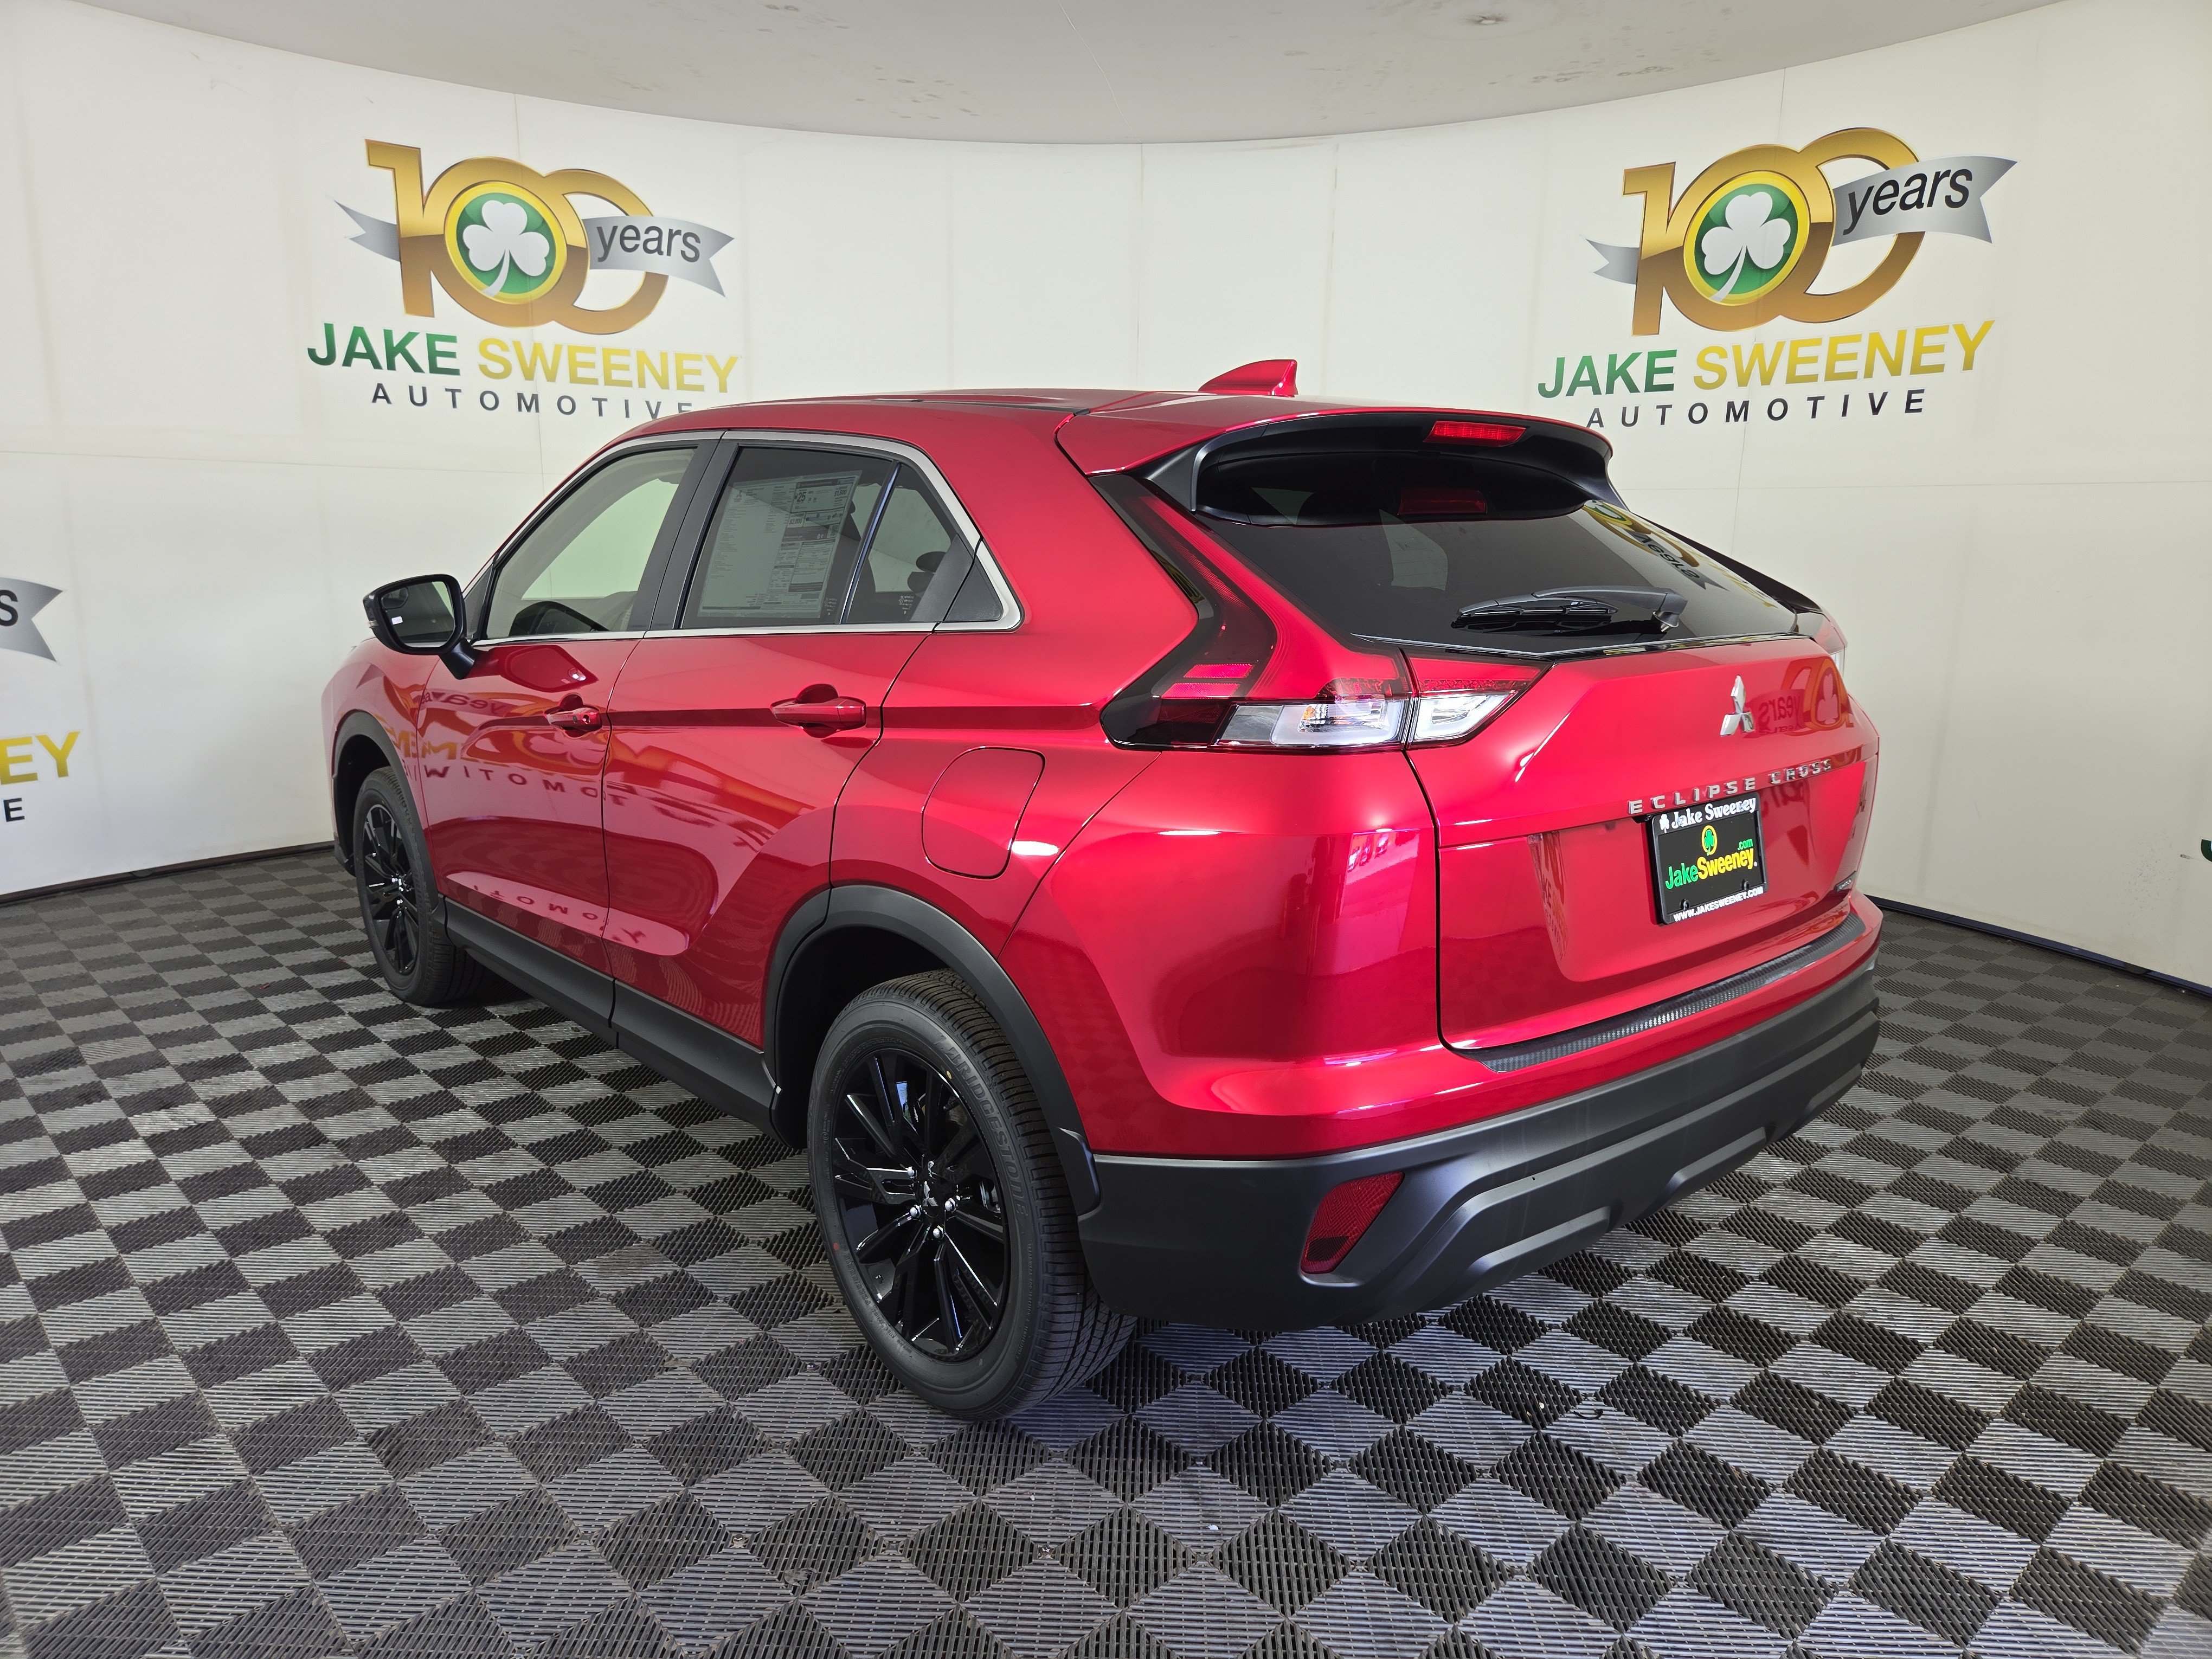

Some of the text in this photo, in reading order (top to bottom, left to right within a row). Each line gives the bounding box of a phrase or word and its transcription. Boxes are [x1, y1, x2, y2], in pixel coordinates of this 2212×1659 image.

[1844, 168, 1973, 235] years
[364, 138, 669, 335] 100
[596, 223, 701, 263] years
[1623, 126, 1926, 337] 100
[307, 323, 740, 394] JAKE SWEENEY
[1538, 319, 1995, 398] JAKE SWEENEY
[1586, 388, 1925, 428] AUTOMOTIVE
[796, 491, 807, 503] 25
[1628, 759, 1832, 814] ECLIPSE CROSS
[1671, 798, 1757, 829] Jake Sweeney
[1737, 838, 1753, 851] .com
